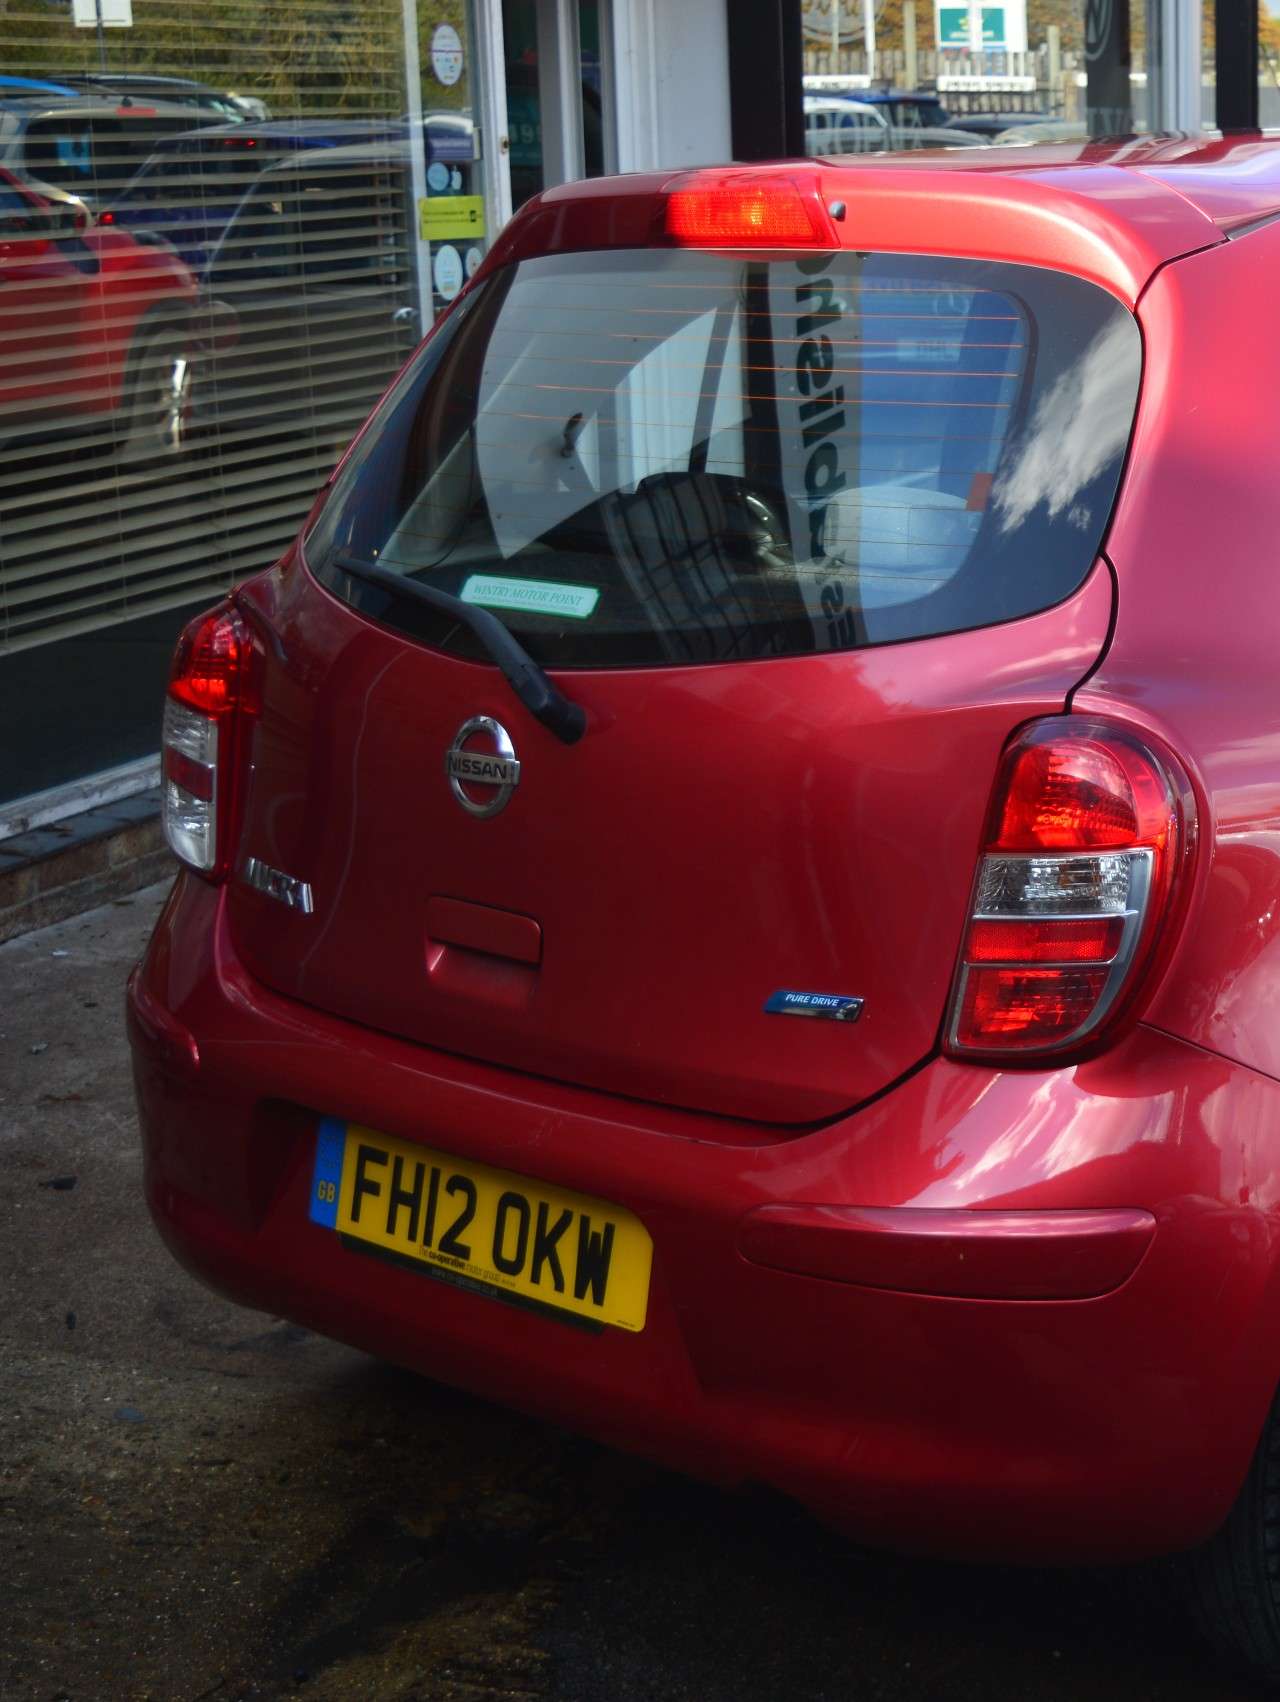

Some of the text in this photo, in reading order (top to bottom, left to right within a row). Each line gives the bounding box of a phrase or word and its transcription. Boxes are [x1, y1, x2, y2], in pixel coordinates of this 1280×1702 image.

[448, 754, 508, 780] NISSAN
[785, 993, 840, 1007] PURE DRIVE
[317, 1180, 336, 1204] GB
[350, 1144, 616, 1308] FH12 OKW
